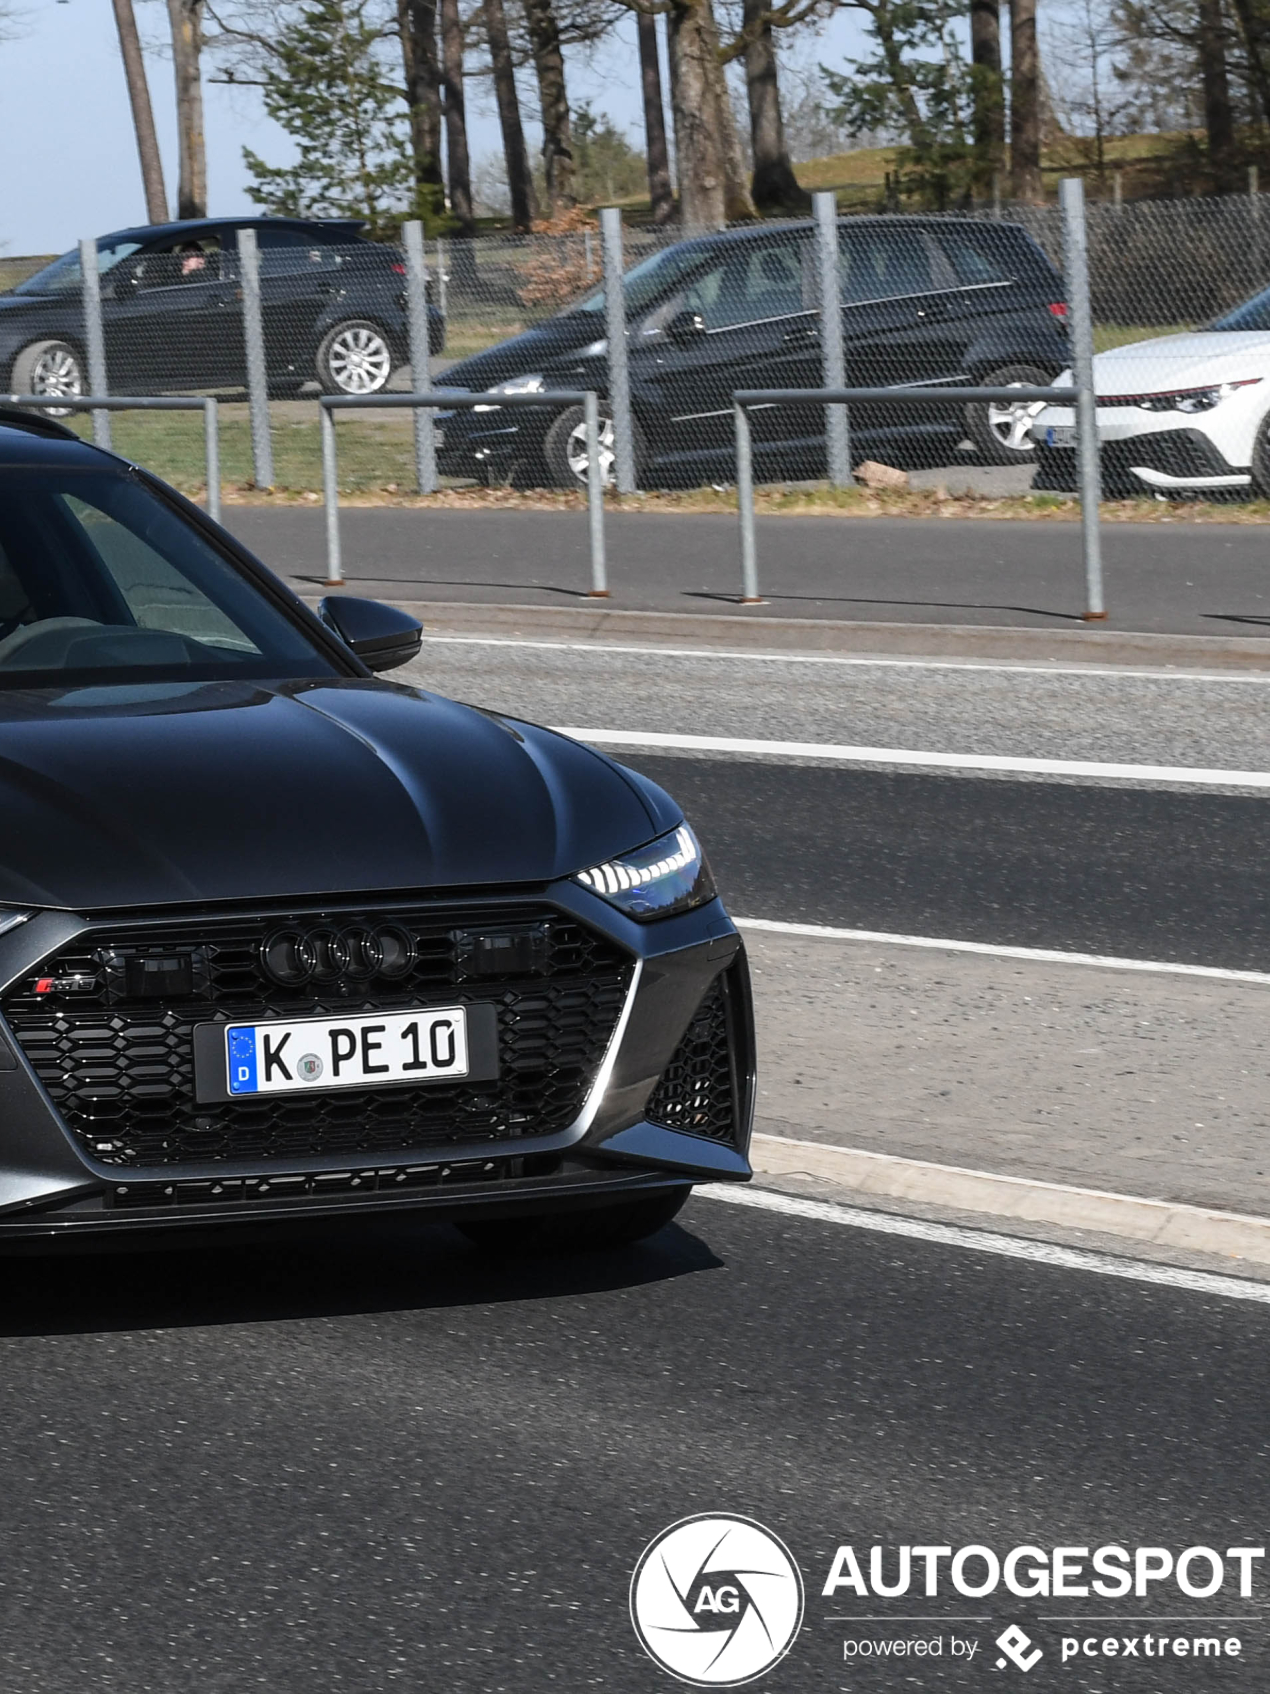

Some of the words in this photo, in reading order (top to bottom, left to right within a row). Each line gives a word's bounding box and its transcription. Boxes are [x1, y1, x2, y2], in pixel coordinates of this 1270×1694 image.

[263, 1032, 293, 1082] K
[328, 1025, 390, 1077] PE
[400, 1019, 456, 1071] 10
[238, 1066, 250, 1081] D
